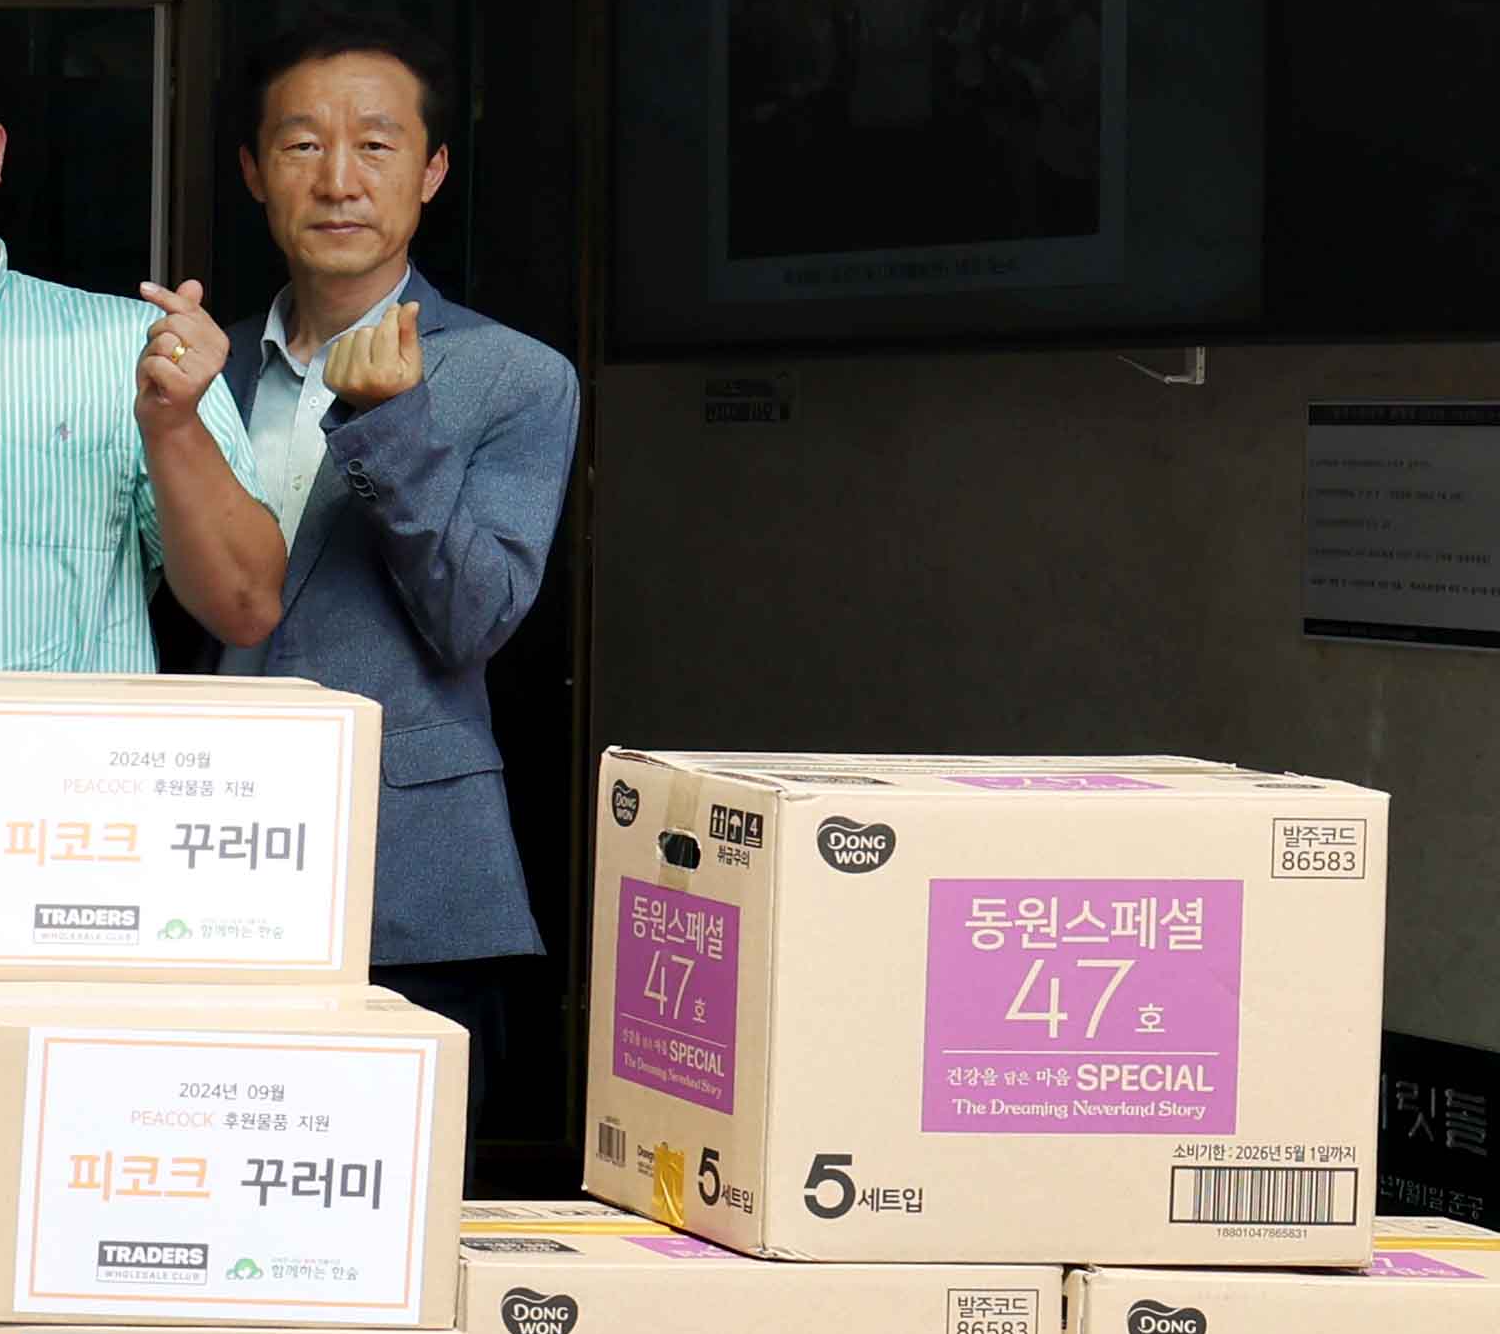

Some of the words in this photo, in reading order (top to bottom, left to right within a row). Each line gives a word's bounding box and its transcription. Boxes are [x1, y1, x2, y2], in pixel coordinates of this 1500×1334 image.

[828, 832, 886, 851] DONG
[1282, 826, 1357, 849] 발주코드
[716, 845, 750, 868] 취급주의
[835, 849, 879, 865] WON
[1281, 851, 1356, 871] 86583
[965, 897, 1204, 951] 동원스페셜
[1076, 1064, 1214, 1092] SPECIAL
[952, 1099, 986, 1117] The
[990, 1099, 1068, 1120] Dreaming
[1073, 1099, 1154, 1119] Neverland
[1158, 1099, 1206, 1120] Story
[1382, 1071, 1487, 1157] 릿돌
